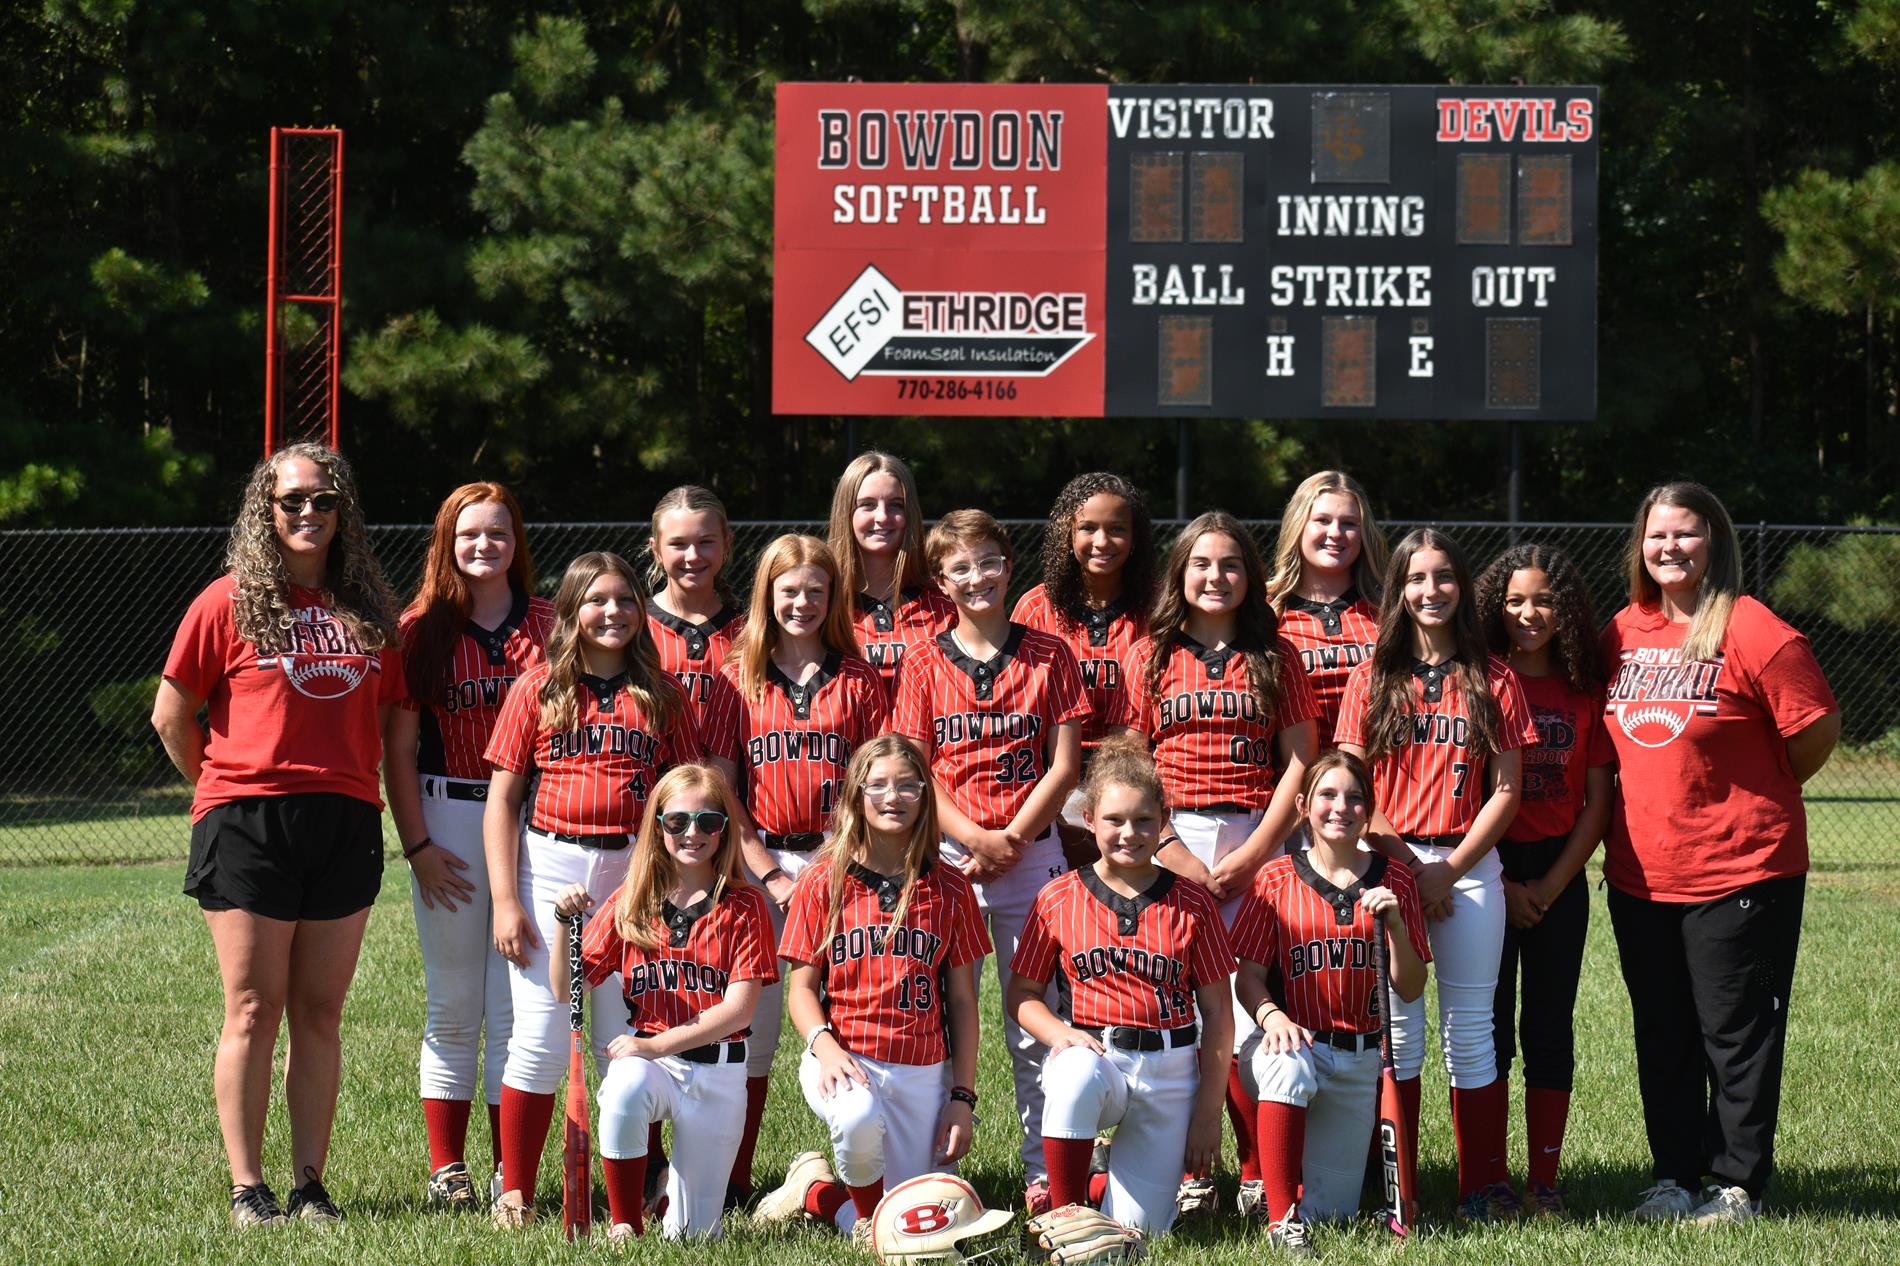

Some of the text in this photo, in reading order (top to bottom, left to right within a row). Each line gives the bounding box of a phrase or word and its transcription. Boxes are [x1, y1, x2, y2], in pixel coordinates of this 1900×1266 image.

[1108, 98, 1275, 139] VISITOR
[1437, 98, 1593, 143] DEVILS
[818, 109, 1064, 171] BOWDON
[833, 184, 1047, 225] SOFTBALL
[1277, 196, 1425, 237] INNING
[1132, 264, 1245, 305] BALL
[1270, 266, 1432, 307] STRIKE
[1471, 267, 1556, 307] OUT
[828, 288, 890, 358] EFSI
[902, 294, 1085, 332] ETHRIDGE
[971, 347, 1057, 362] Insulation
[1266, 336, 1296, 376] H
[1409, 337, 1434, 377] E
[897, 380, 1017, 400] 770-286-4166
[549, 724, 660, 767] BOWDON
[748, 731, 851, 768] BOWDON
[934, 712, 1042, 748] BOWDON
[995, 748, 1038, 784] 32
[1230, 735, 1270, 767] 00
[627, 769, 647, 801] 4
[1451, 762, 1469, 799] 7
[831, 925, 942, 968] BOWDON
[1072, 946, 1184, 987] BOWDON
[630, 958, 730, 999] BOWDON
[898, 974, 932, 1010] 13
[1154, 985, 1188, 1021] 14
[1381, 1124, 1402, 1226] QUEST
[900, 1204, 950, 1234] B
